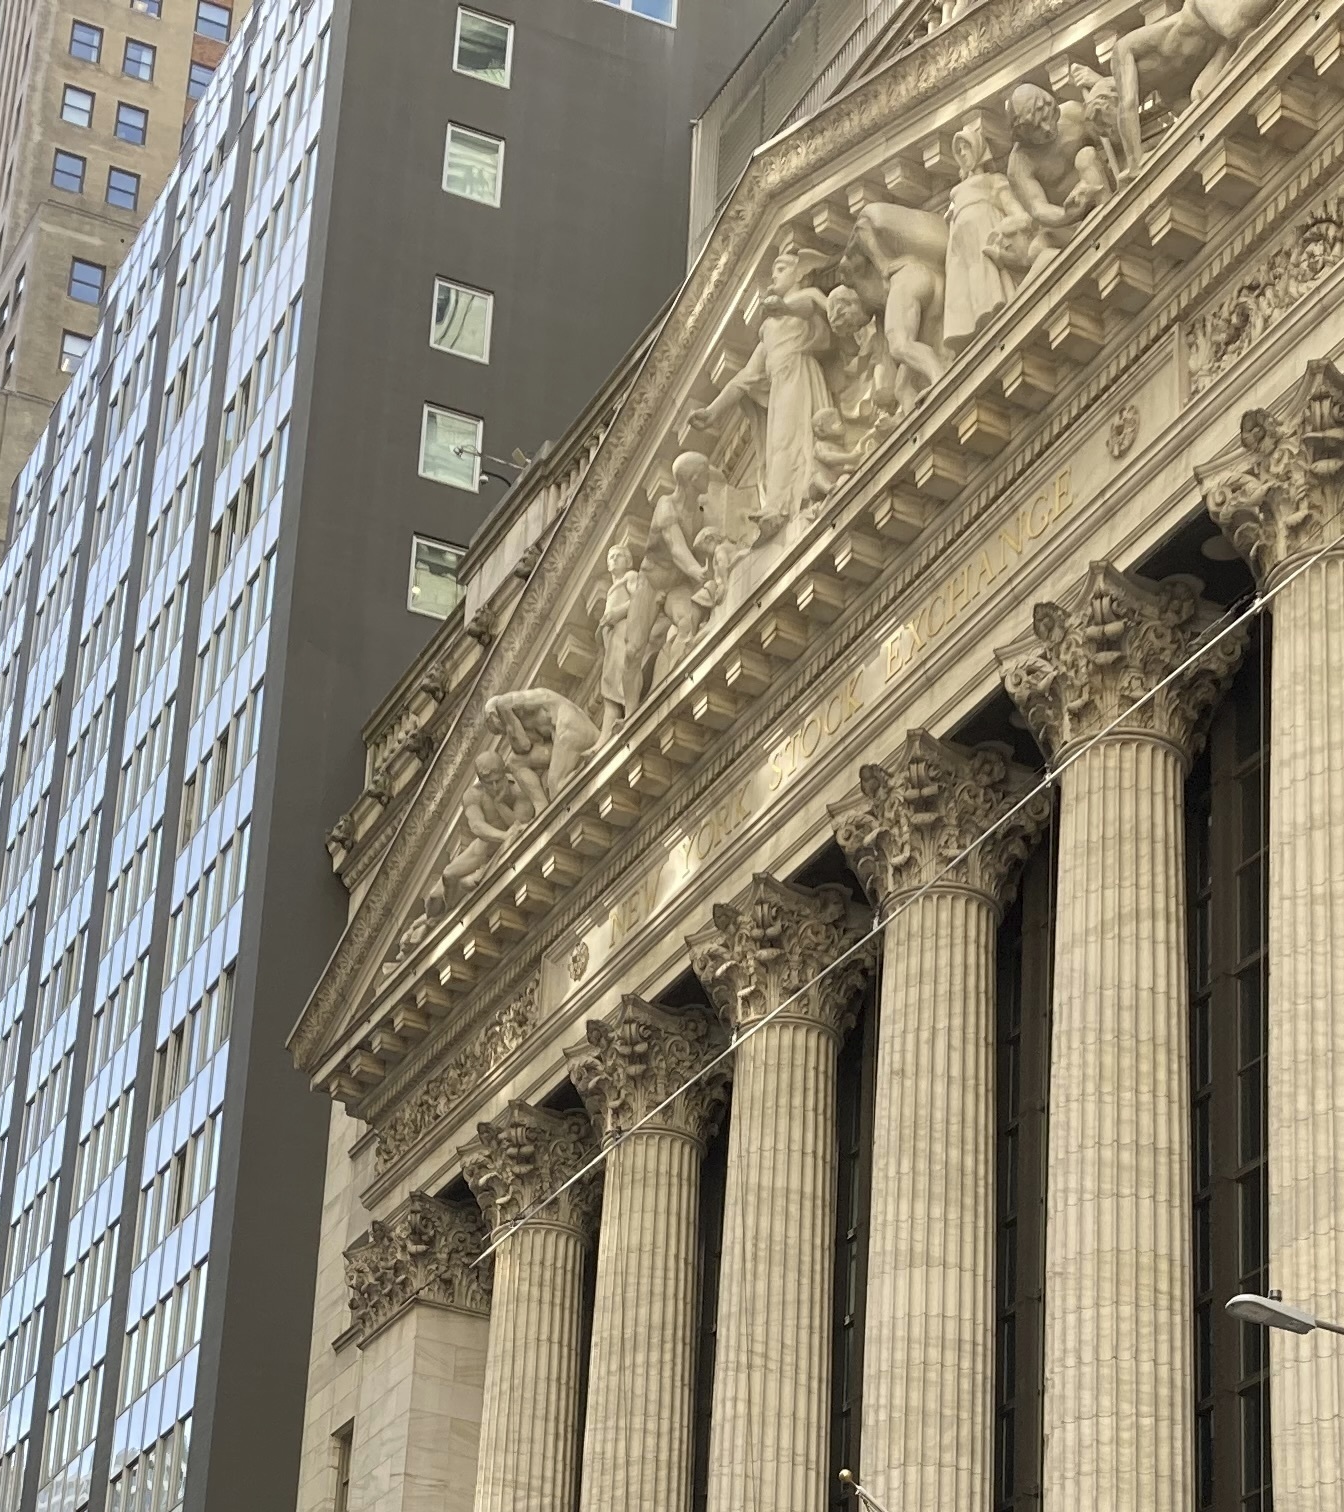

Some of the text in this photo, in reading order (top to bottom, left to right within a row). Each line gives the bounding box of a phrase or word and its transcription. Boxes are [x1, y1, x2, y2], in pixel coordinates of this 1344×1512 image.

[609, 466, 1074, 948] NEW YORK STOCK EXCHANGE
